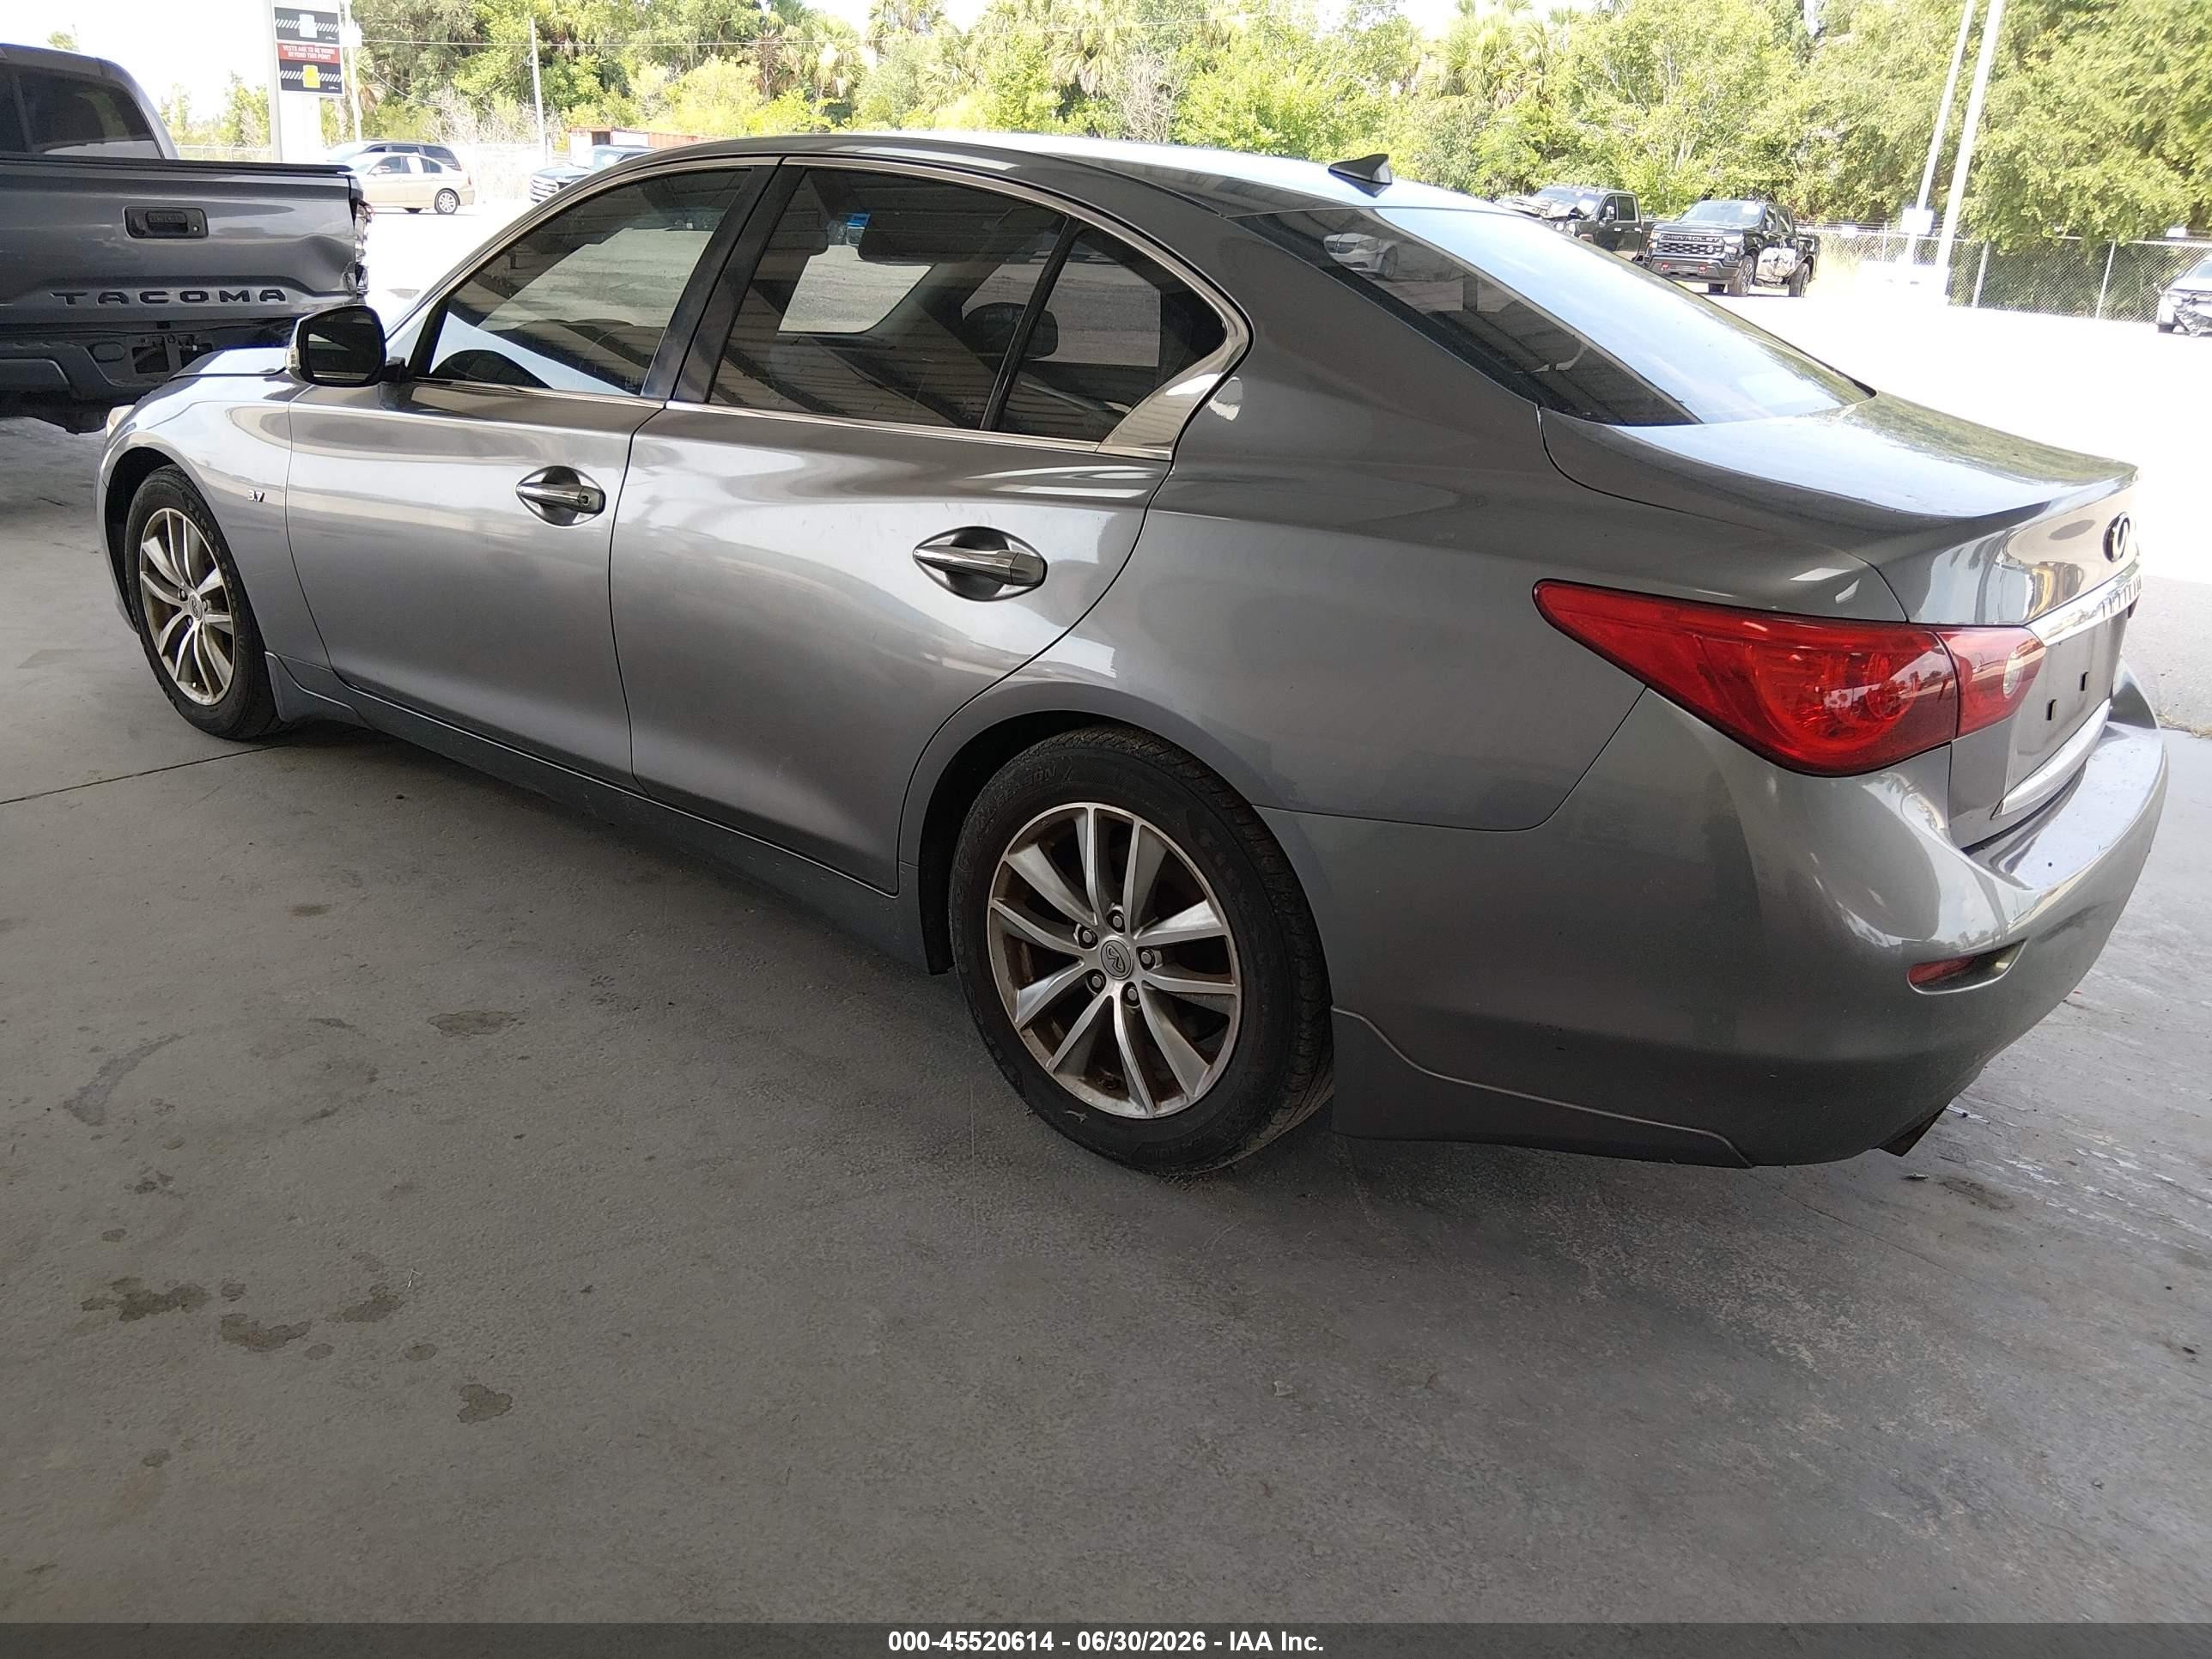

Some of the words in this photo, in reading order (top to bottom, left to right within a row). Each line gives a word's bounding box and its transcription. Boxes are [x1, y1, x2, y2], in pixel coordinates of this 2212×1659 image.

[1661, 234, 1720, 242] CHEVROLET
[50, 289, 287, 305] TACOMA
[247, 489, 264, 502] 3.7
